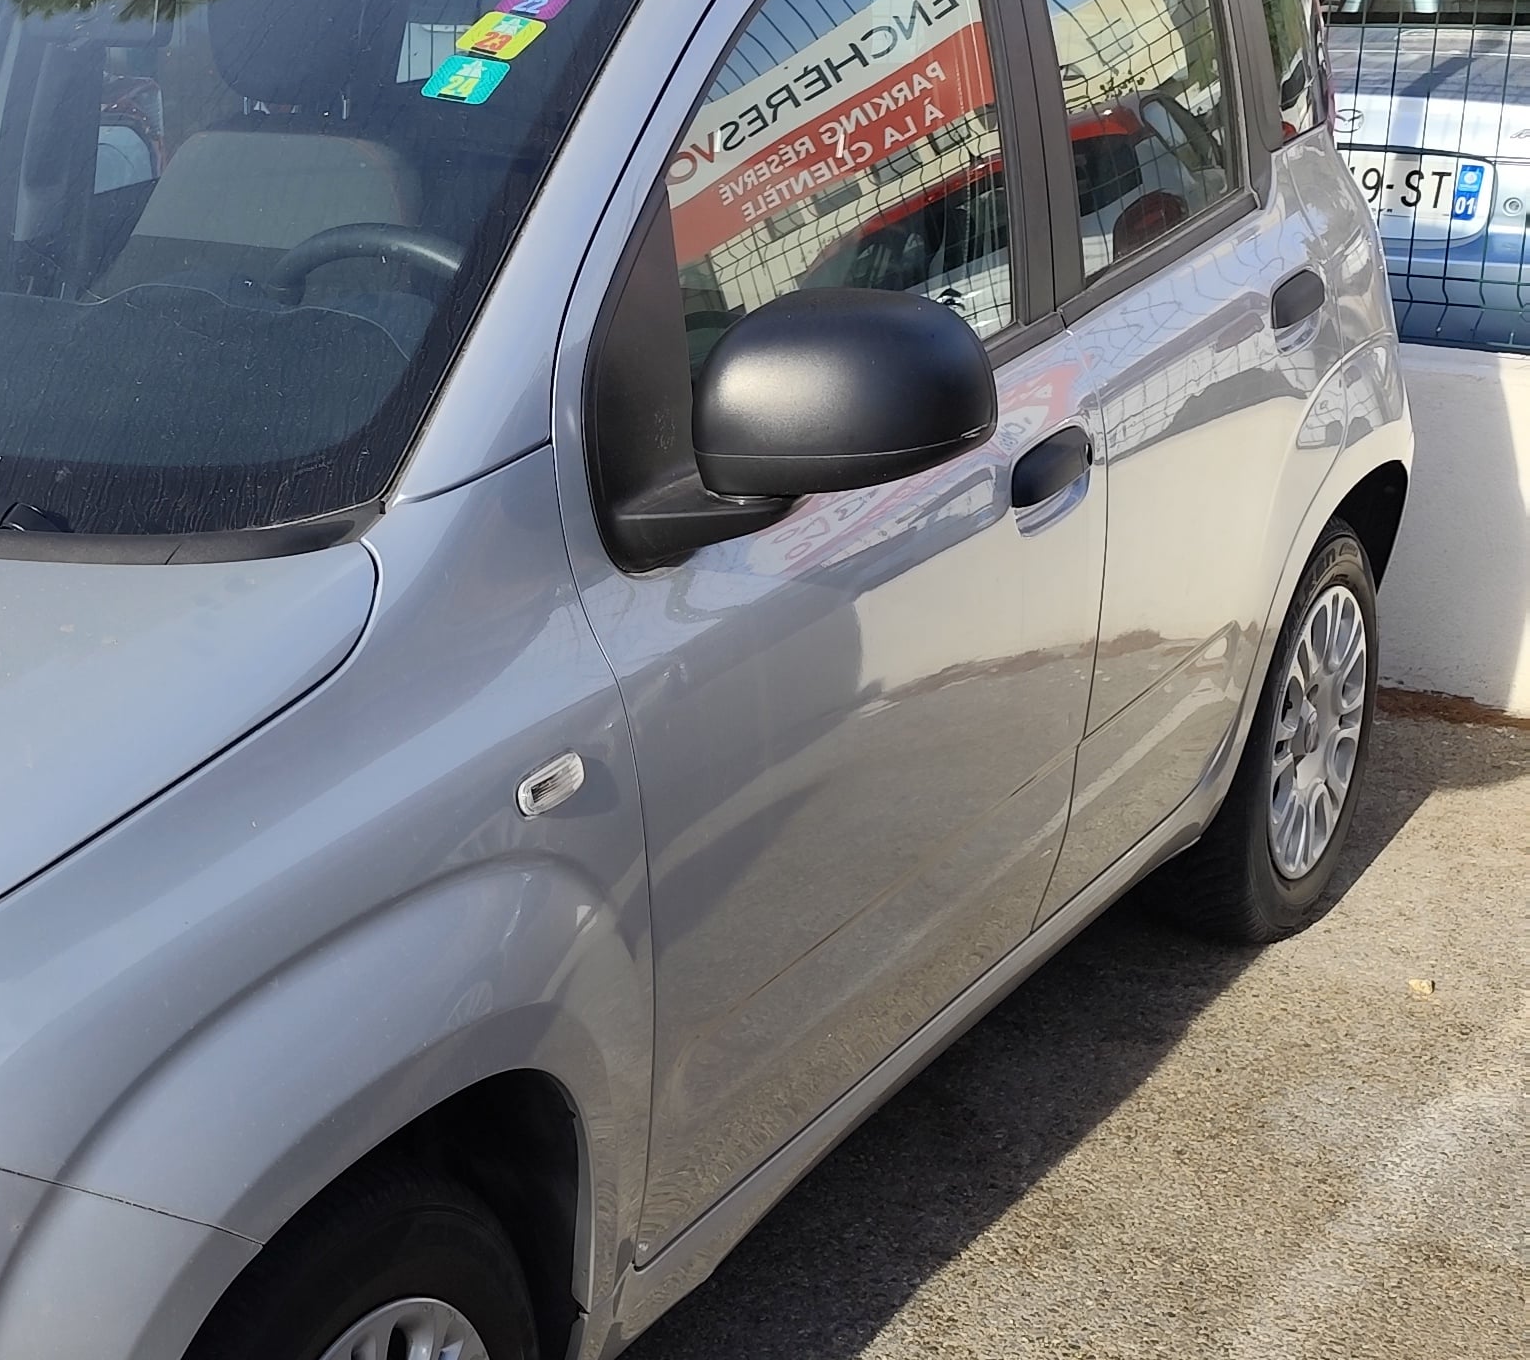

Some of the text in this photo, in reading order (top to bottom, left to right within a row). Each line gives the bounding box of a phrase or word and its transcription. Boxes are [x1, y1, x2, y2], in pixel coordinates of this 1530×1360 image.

[472, 31, 512, 51] 23
[439, 74, 479, 96] 24
[1350, 167, 1452, 208] 9-ST
[1455, 196, 1475, 215] 01
